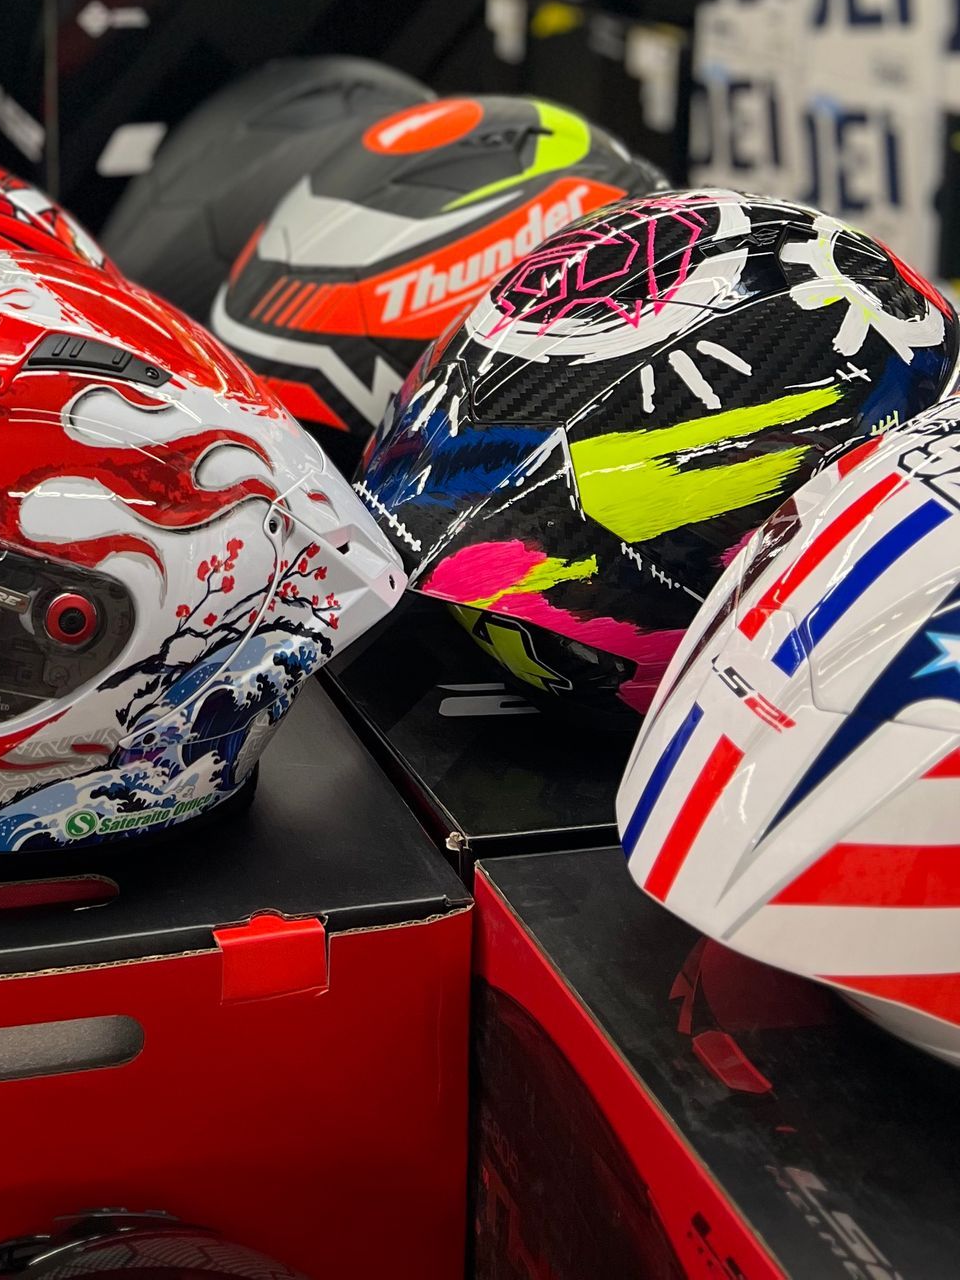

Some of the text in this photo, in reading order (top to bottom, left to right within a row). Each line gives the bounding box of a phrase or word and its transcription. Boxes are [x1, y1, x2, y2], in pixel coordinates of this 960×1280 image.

[374, 185, 590, 323] Thunder
[711, 653, 796, 734] LS2
[98, 807, 170, 833] Sateraito
[173, 792, 213, 817] Office
